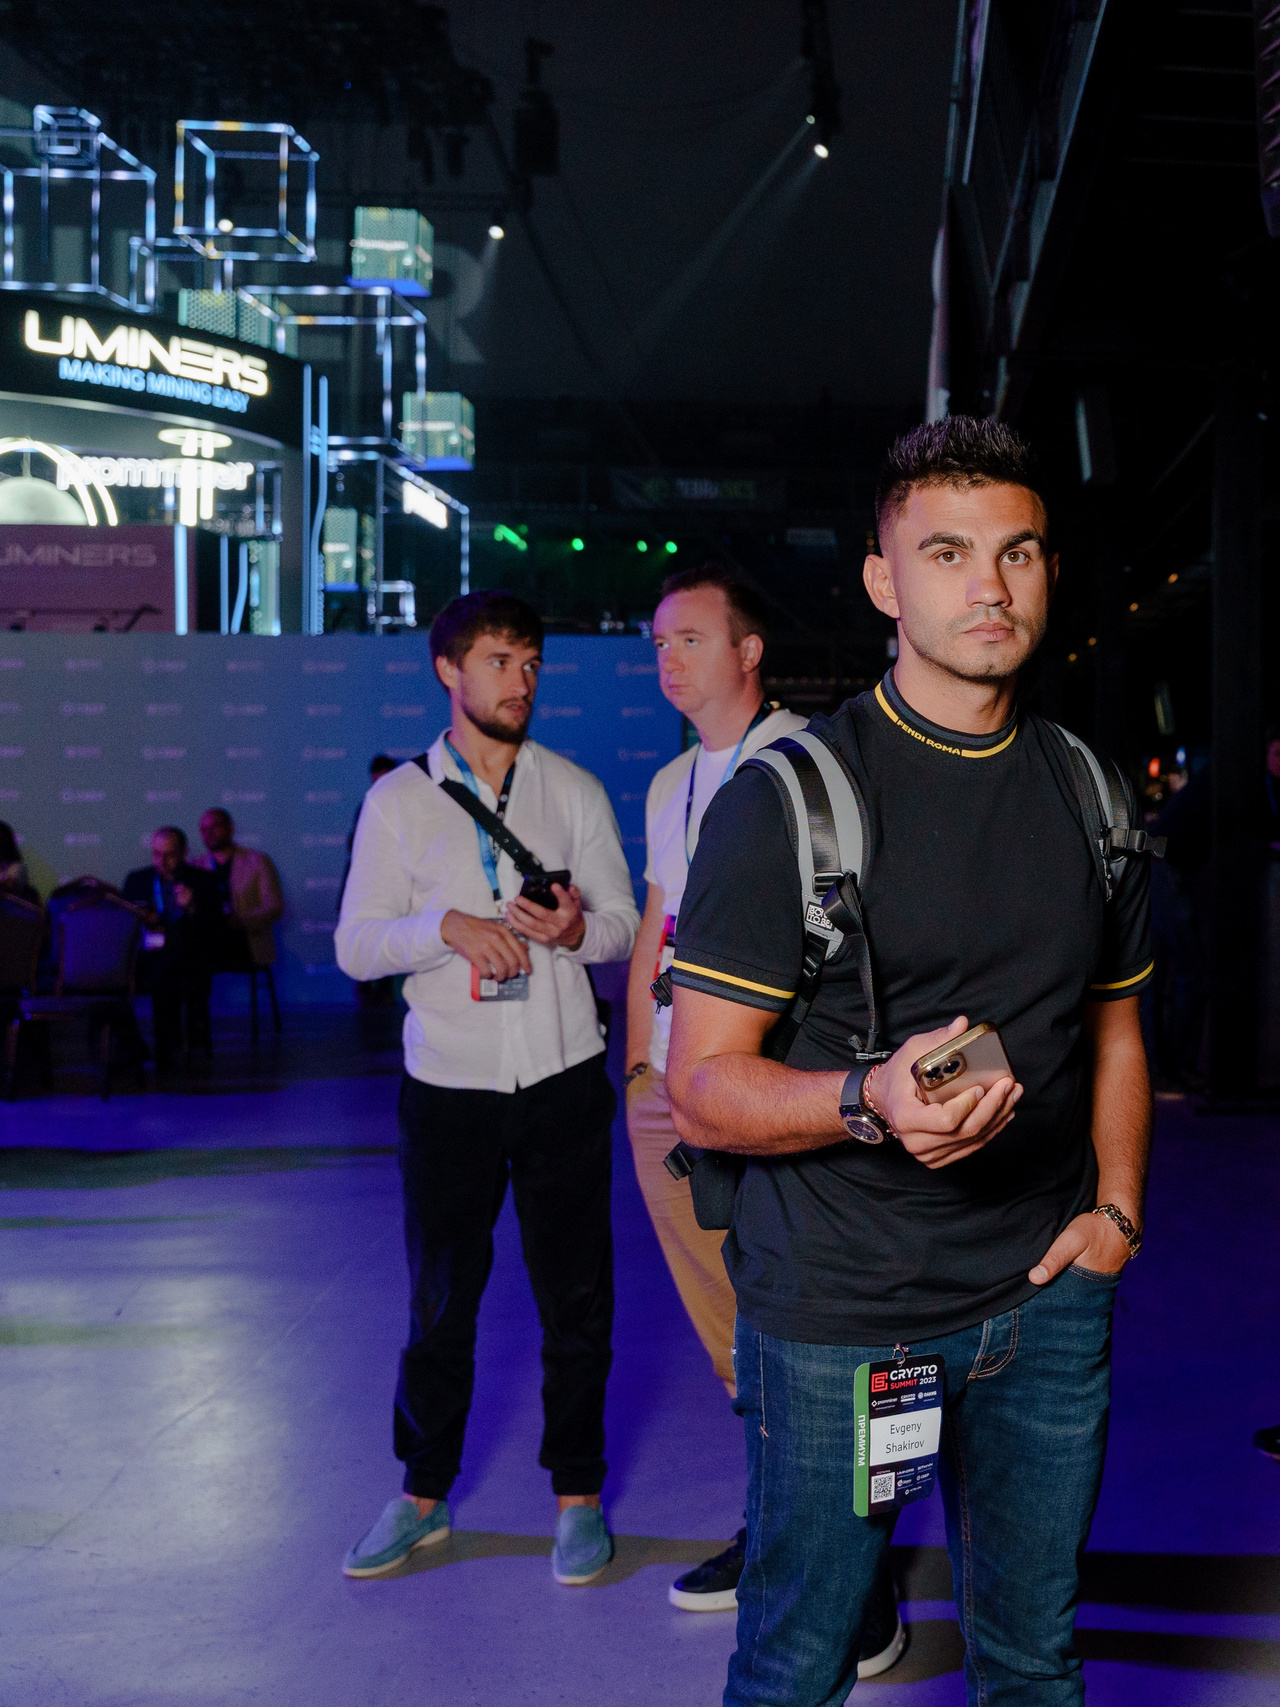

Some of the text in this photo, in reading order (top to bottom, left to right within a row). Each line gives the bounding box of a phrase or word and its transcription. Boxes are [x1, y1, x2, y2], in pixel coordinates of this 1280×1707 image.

[25, 310, 269, 396] UMINERS
[59, 357, 249, 413] MAKING MINING EASY
[896, 719, 961, 756] FENDI ROMA
[890, 1364, 938, 1381] CRYPTO
[890, 1376, 937, 1390] SUMMIT 2023
[857, 1414, 866, 1467] ПРЕМИУМ
[890, 1422, 922, 1436] Evgeny
[885, 1439, 925, 1454] Shakirov
